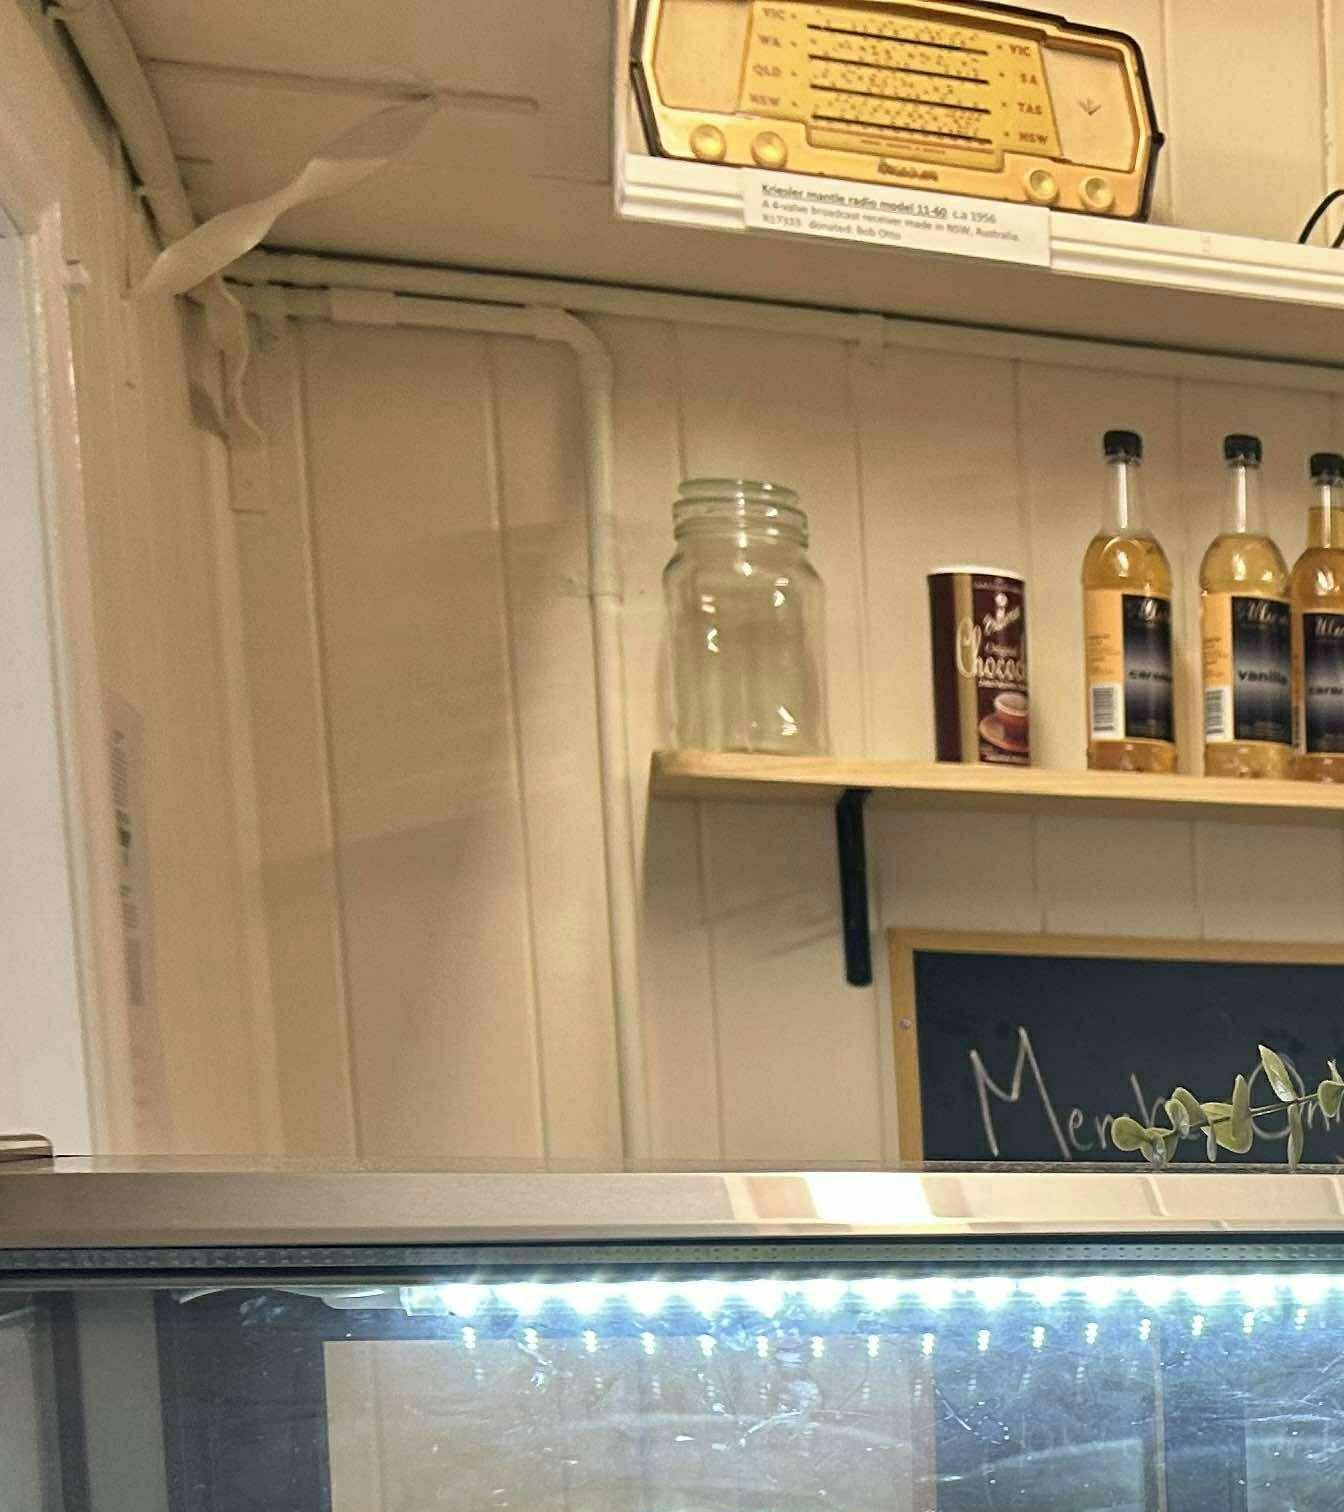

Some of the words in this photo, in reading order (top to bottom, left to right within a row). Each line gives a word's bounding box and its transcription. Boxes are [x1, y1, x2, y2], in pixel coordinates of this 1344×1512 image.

[807, 191, 845, 205] mantle
[848, 196, 878, 208] radio
[880, 201, 915, 214] model
[1237, 669, 1289, 686] vanilla
